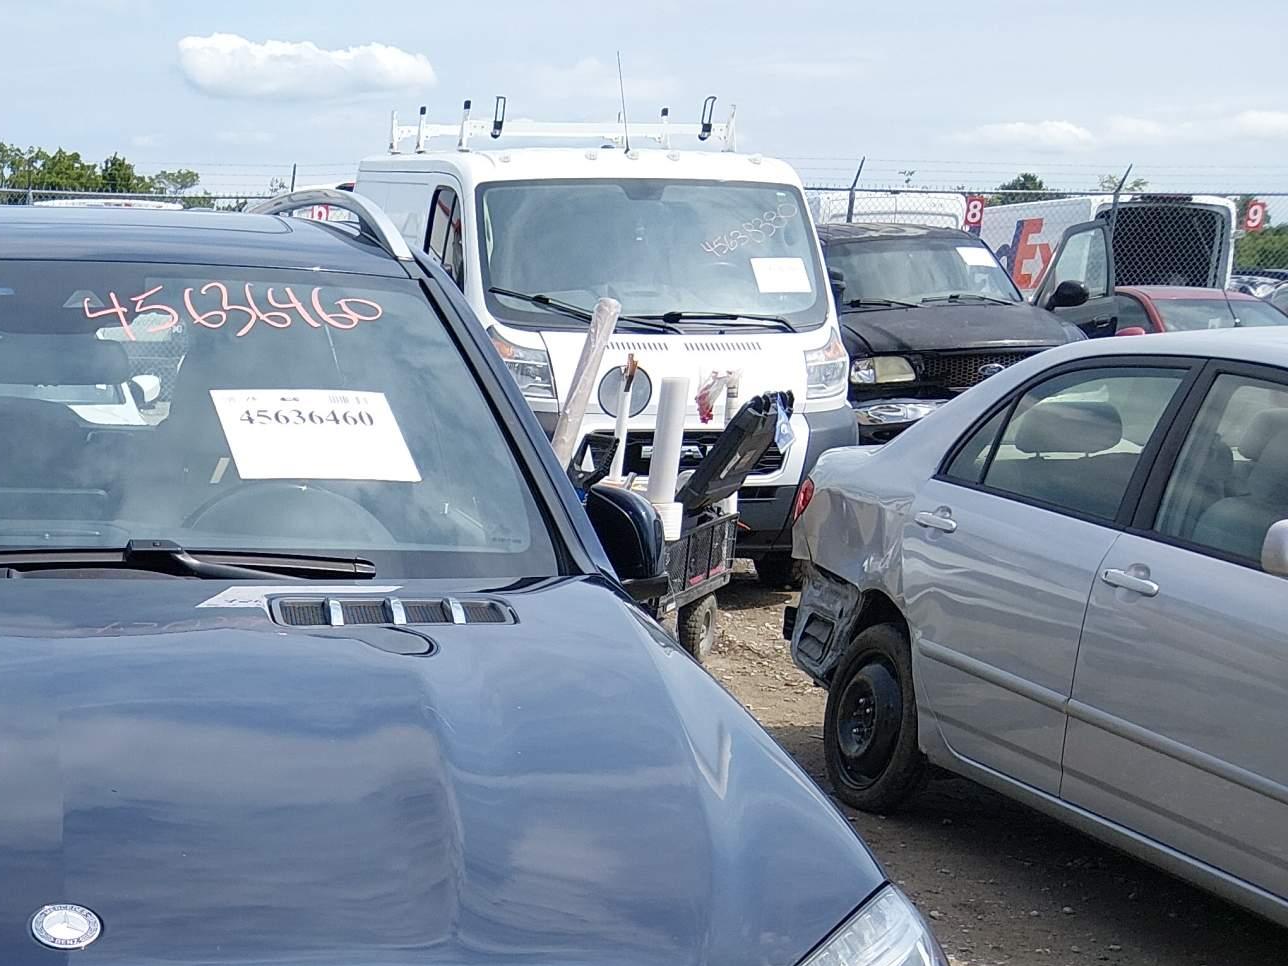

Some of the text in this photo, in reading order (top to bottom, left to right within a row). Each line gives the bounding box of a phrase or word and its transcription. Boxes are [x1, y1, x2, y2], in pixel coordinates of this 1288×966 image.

[966, 200, 982, 223] 8
[1246, 204, 1263, 228] 9
[83, 281, 383, 341] 45636460
[239, 408, 375, 427] 45636460
